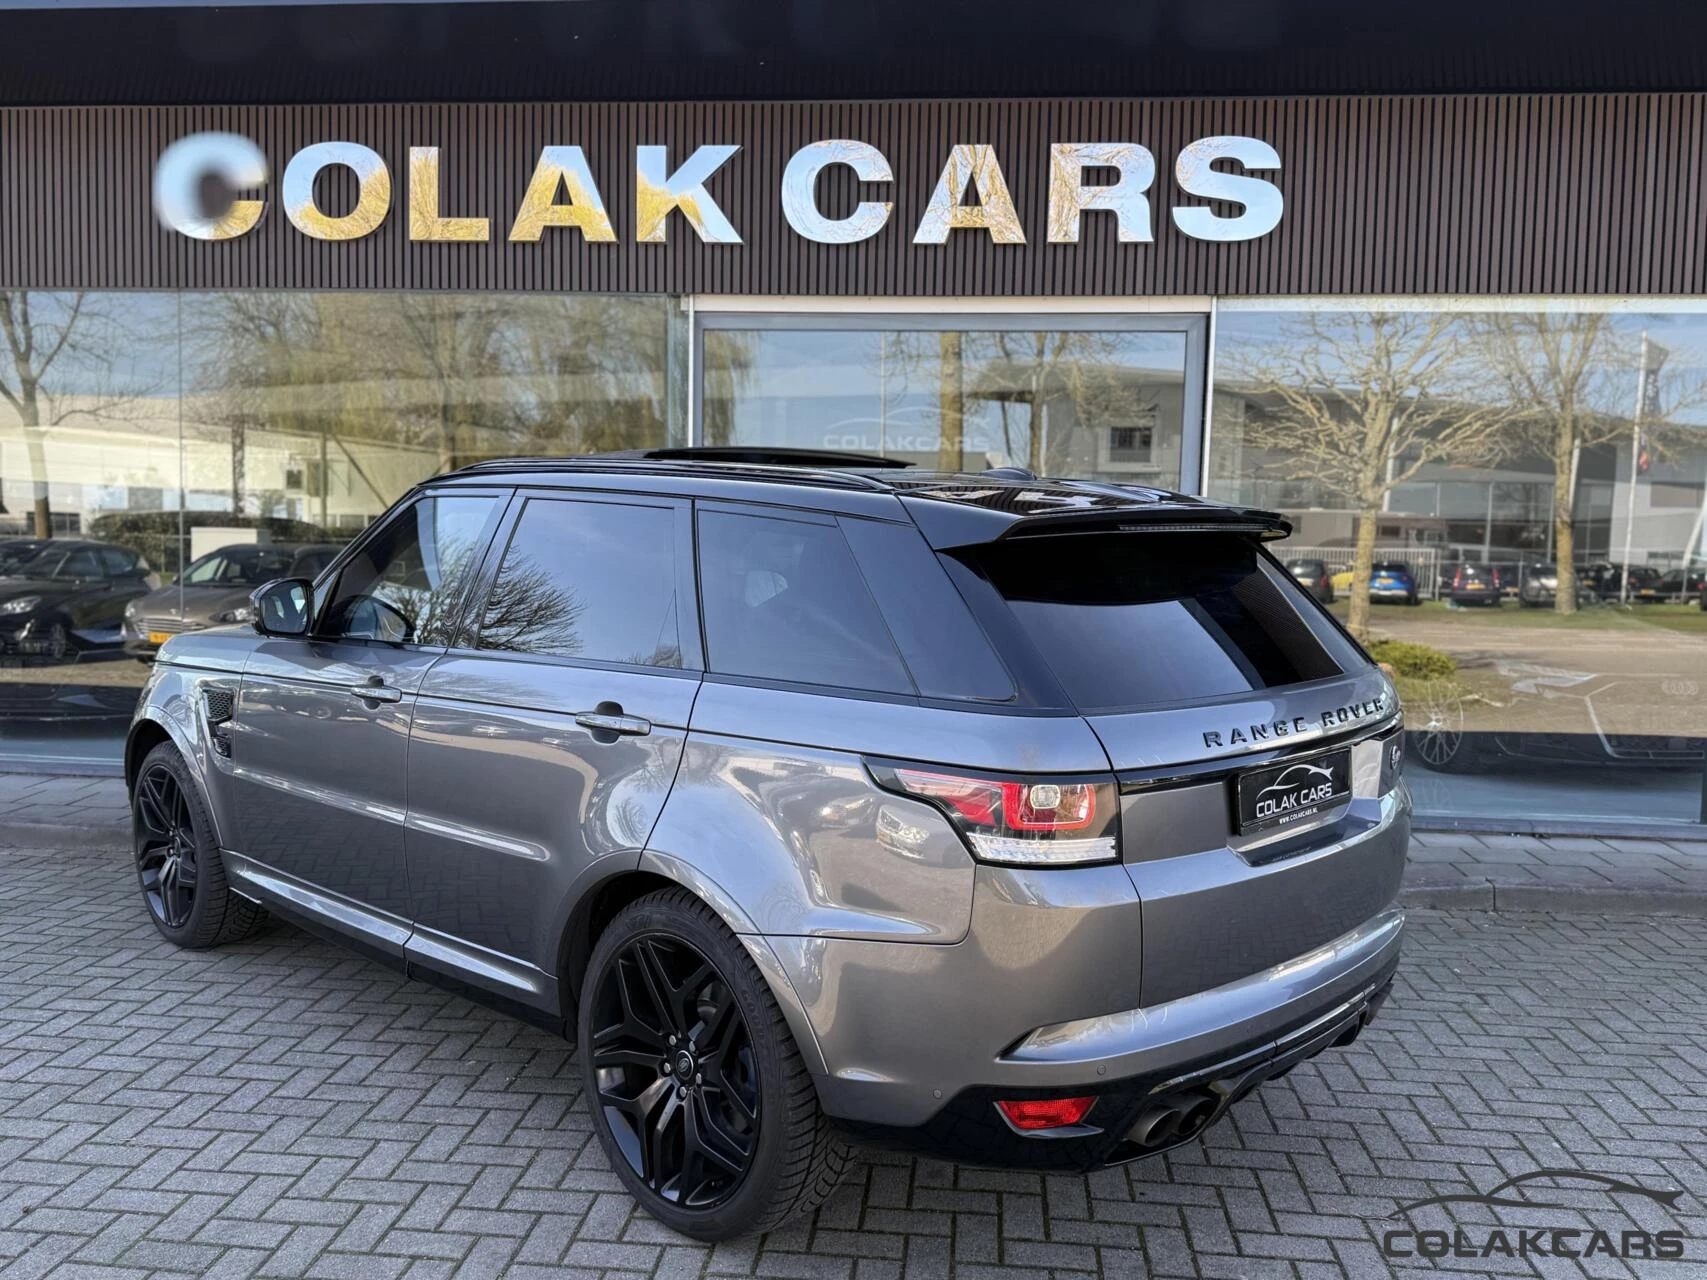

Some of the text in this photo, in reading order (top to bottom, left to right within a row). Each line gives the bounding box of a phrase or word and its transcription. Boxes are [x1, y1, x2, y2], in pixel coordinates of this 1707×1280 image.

[153, 130, 1284, 245] COLAK CARS
[822, 434, 990, 451] COLAKCARS
[1202, 698, 1384, 748] RANGE ROVER
[1256, 782, 1332, 818] COLAK CARS
